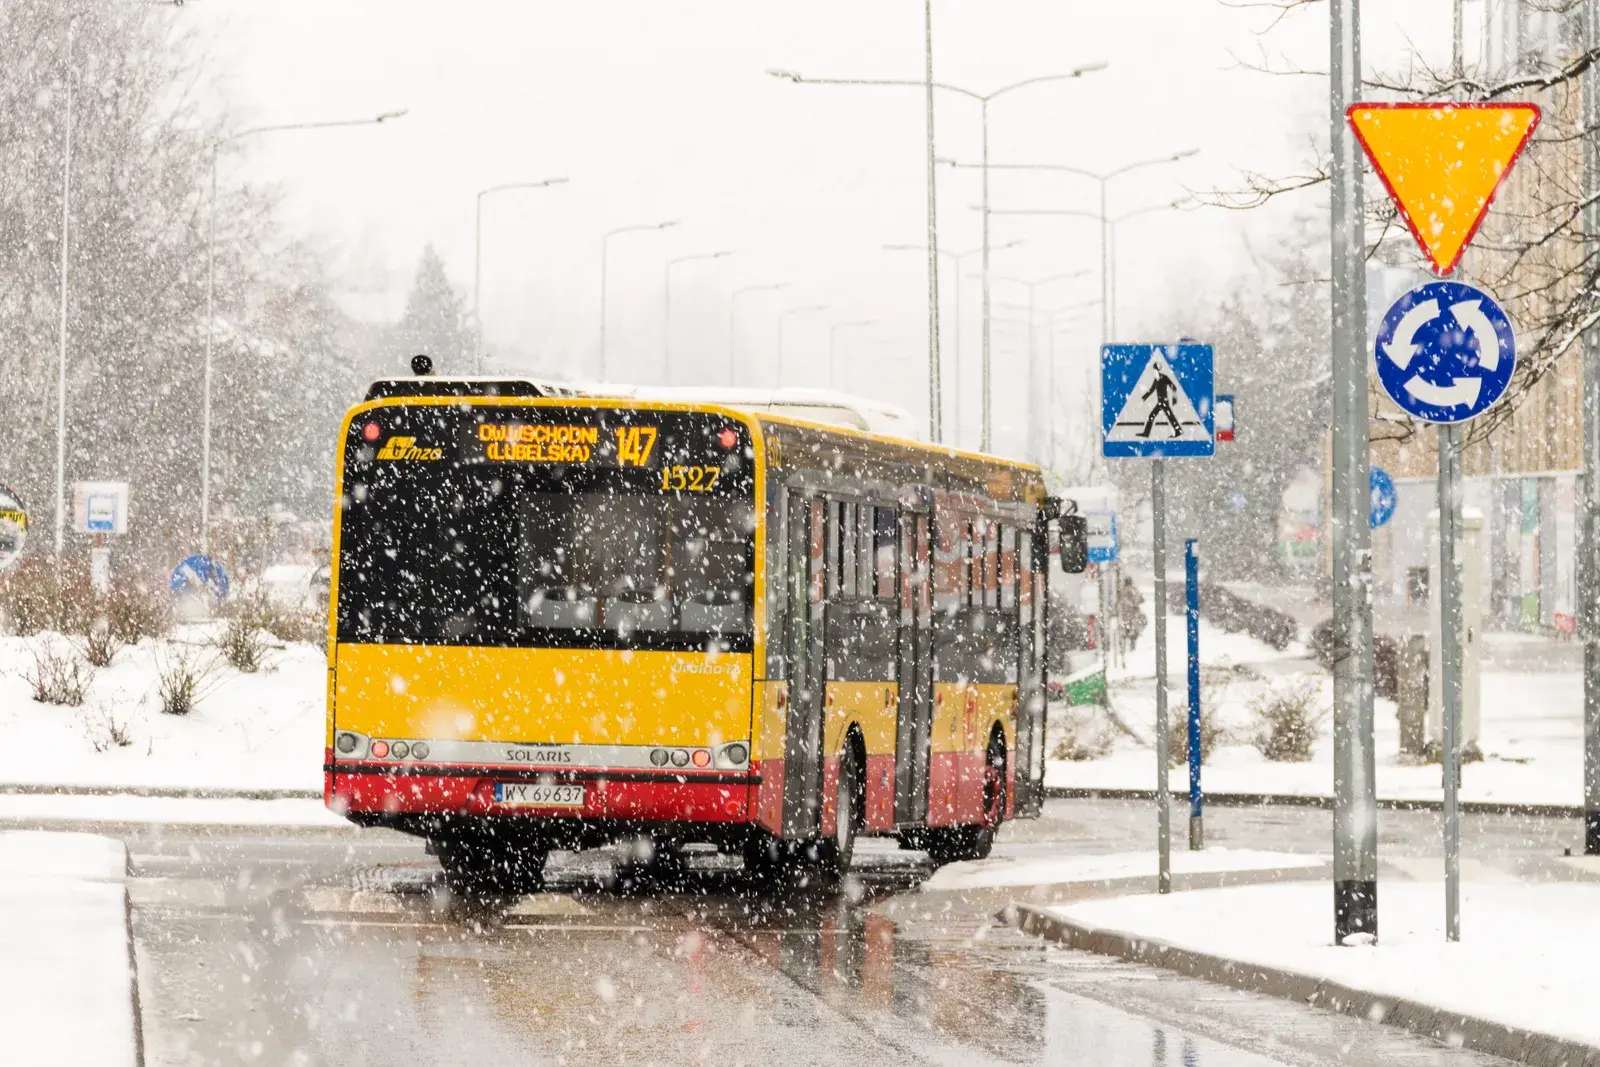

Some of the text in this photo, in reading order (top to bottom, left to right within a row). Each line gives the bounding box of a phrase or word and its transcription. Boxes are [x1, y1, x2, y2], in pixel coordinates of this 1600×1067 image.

[487, 442, 590, 462] (LUBELSKA)
[615, 426, 657, 467] 147
[661, 465, 720, 491] 1527
[506, 750, 571, 762] SOLARIS
[533, 787, 581, 802] 69637
